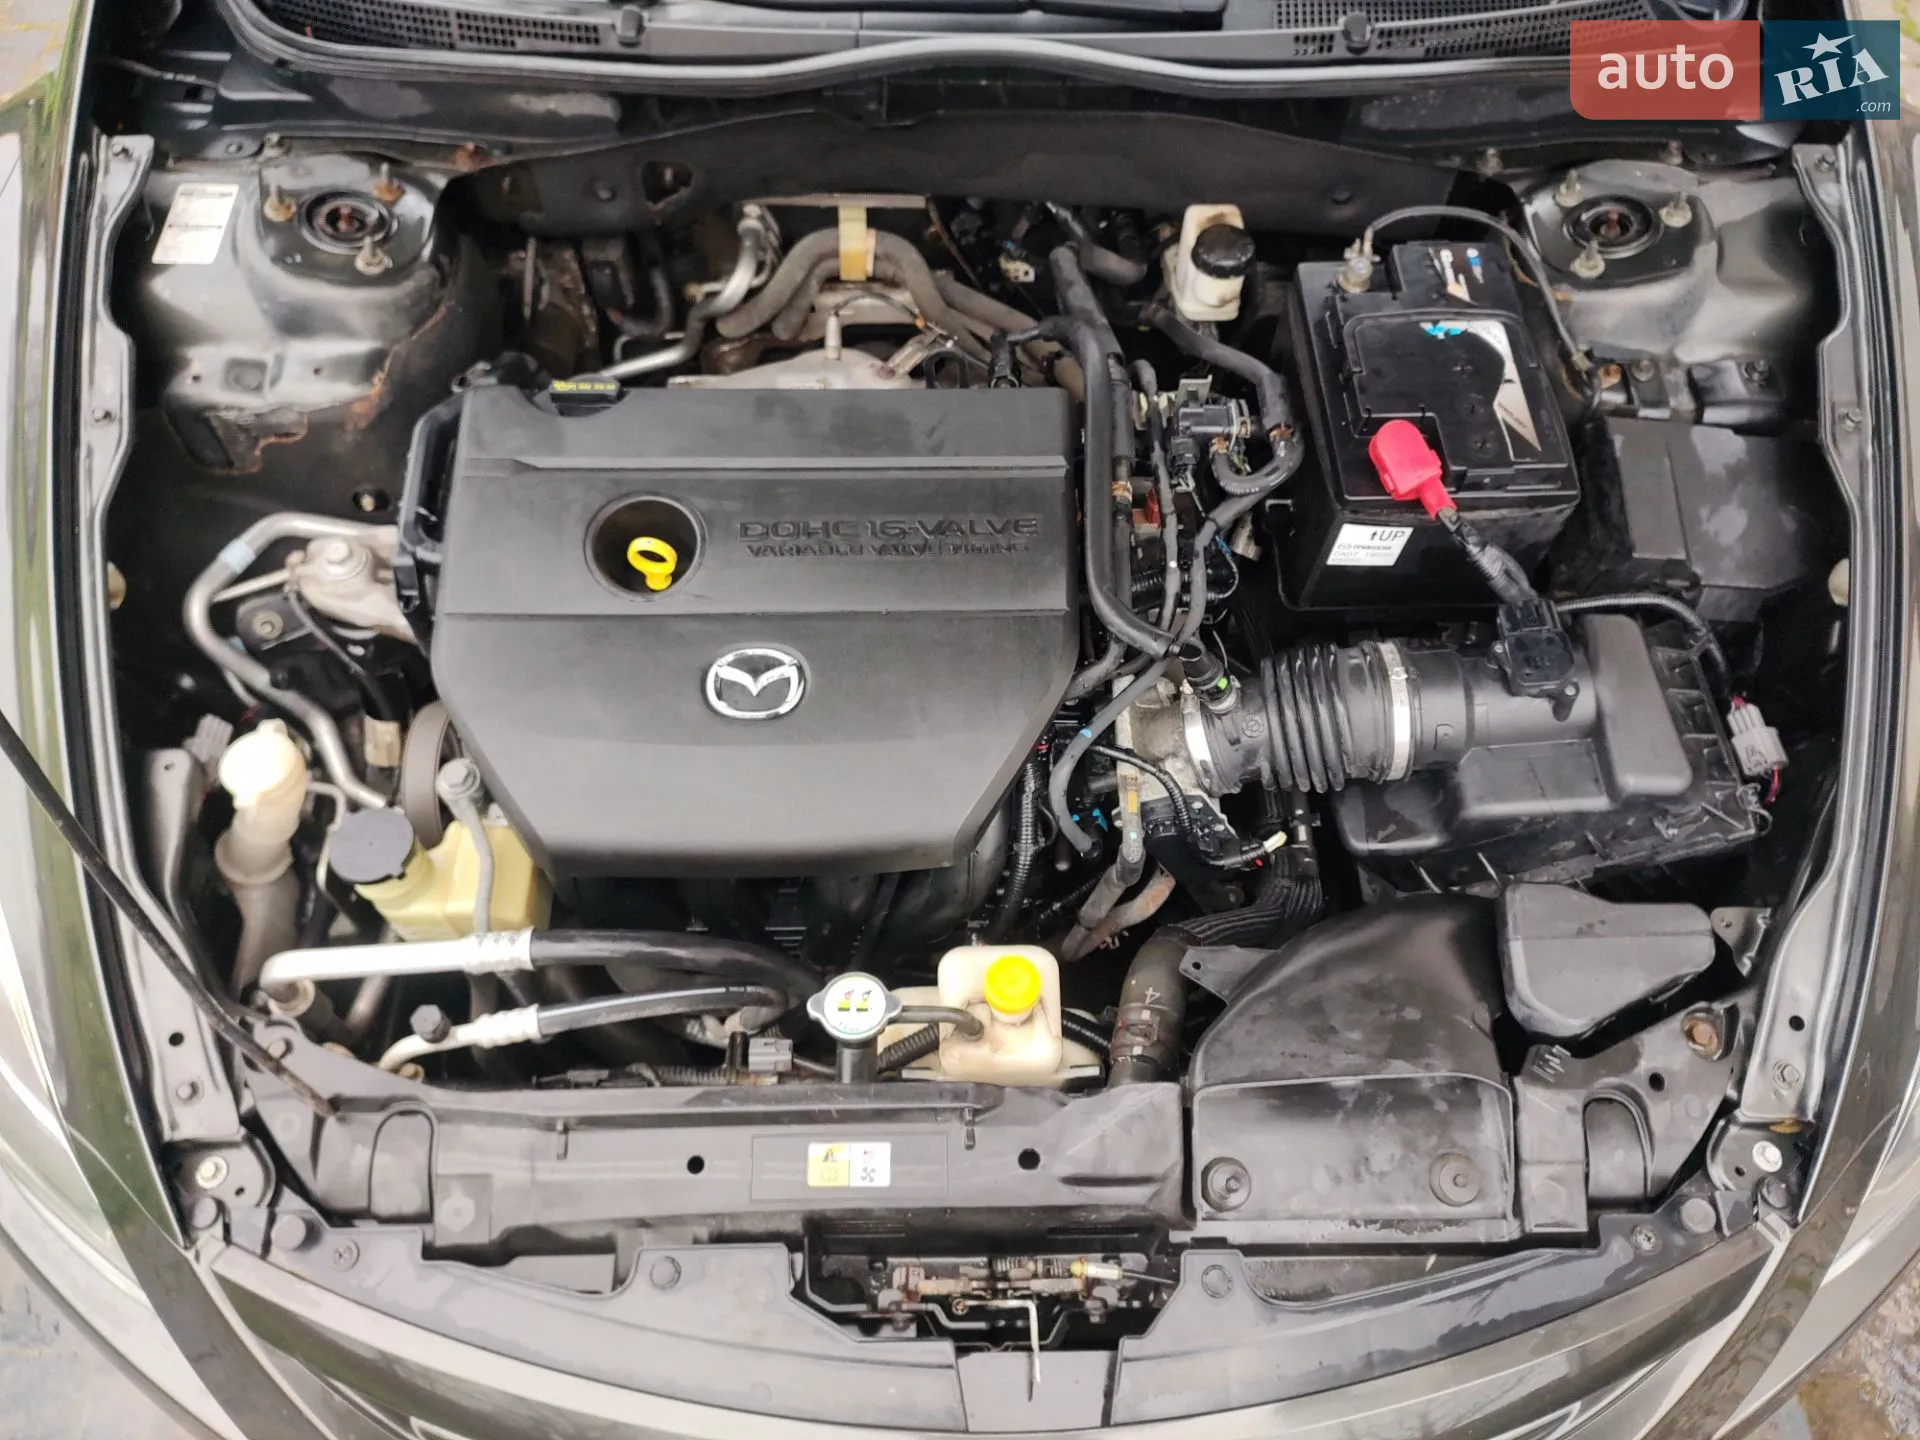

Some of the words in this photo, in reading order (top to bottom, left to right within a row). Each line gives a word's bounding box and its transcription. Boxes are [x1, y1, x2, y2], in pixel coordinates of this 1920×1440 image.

[738, 520, 862, 541] DOHC
[866, 518, 1038, 539] 16-VALVE
[1379, 529, 1405, 541] UP
